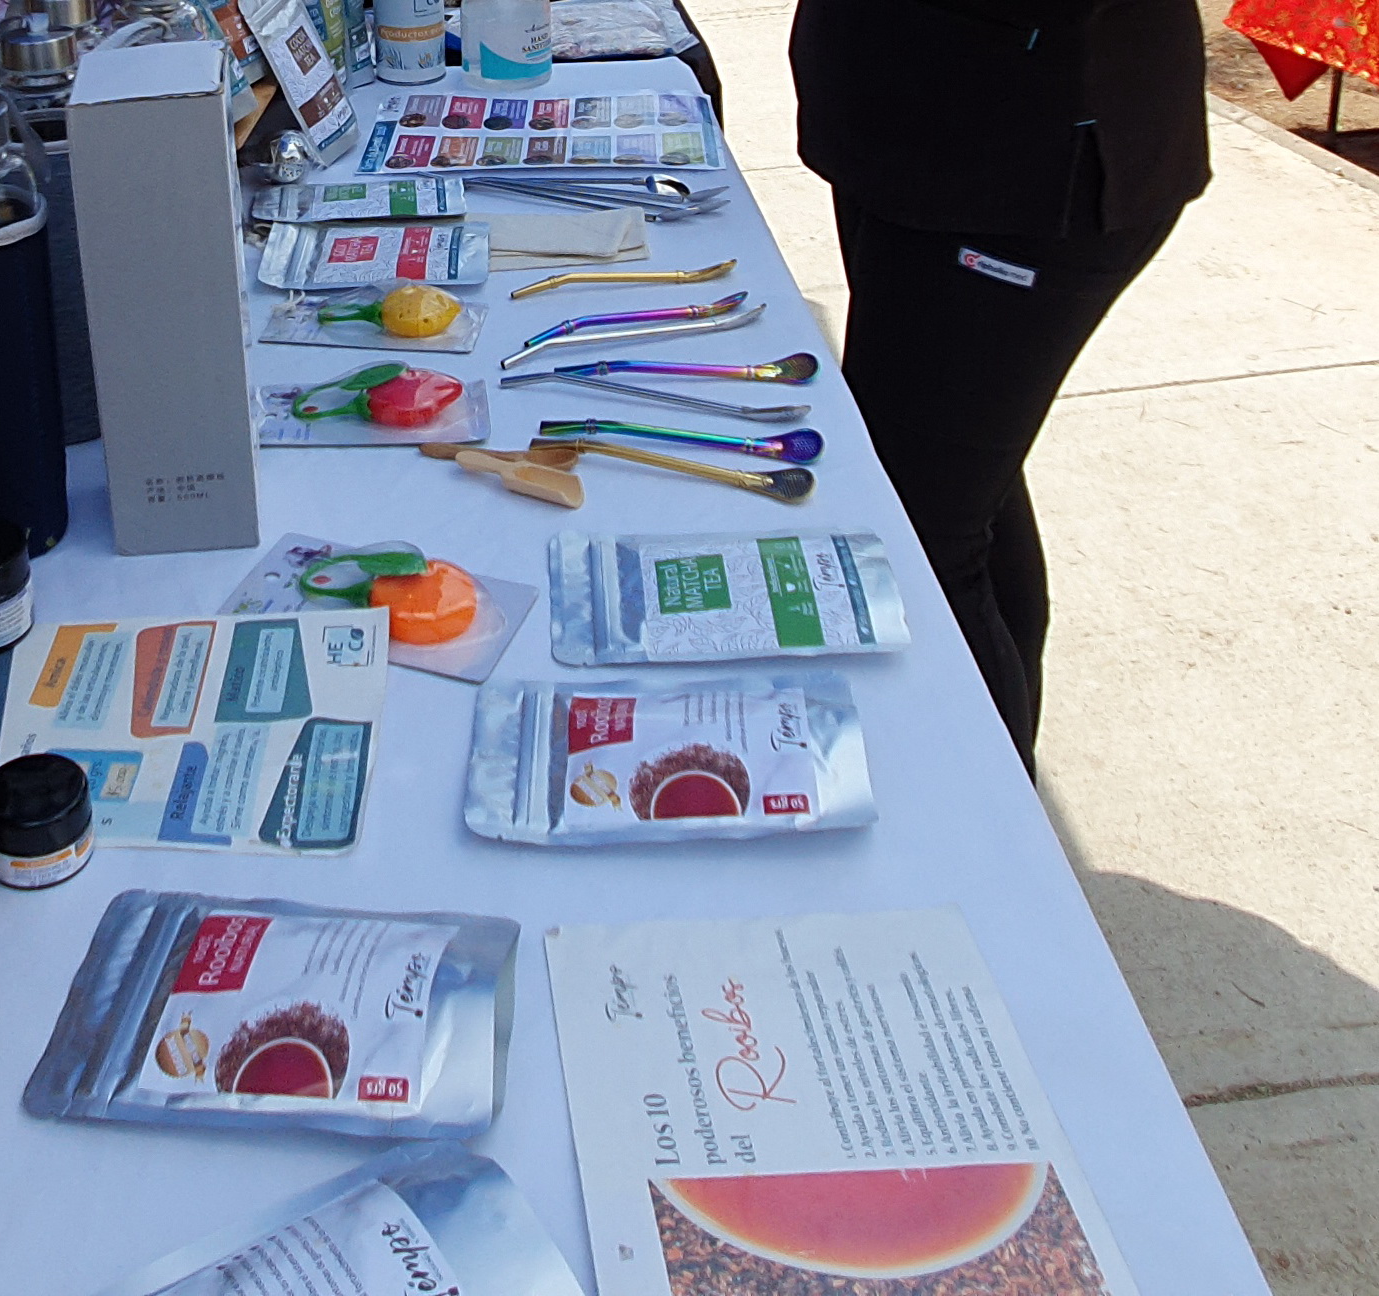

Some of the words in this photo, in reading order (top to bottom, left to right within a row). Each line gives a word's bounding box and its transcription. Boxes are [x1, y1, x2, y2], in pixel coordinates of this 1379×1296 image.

[662, 563, 679, 607] Natural
[683, 556, 704, 610] MATCHA
[703, 566, 721, 592] TEA
[327, 641, 344, 665] HE
[169, 763, 198, 822] Relajante
[277, 752, 303, 839] Expectorante
[199, 917, 248, 987] Rooibos
[663, 973, 698, 1068] beneficios
[702, 977, 797, 1112] Rooibos
[884, 1039, 909, 1081] sistema
[917, 1030, 955, 1097] irritabilidad
[939, 1030, 974, 1088] problemas
[955, 1023, 983, 1071] radicales
[849, 1050, 872, 1087] niveles
[643, 1093, 671, 1118] 10
[689, 1067, 727, 1166] poderosos
[983, 1090, 1014, 1140] Combate
[994, 1070, 1025, 1117] contiene
[821, 1089, 854, 1151] Contribuye
[850, 1113, 876, 1147] Ayuda
[869, 1107, 893, 1146] Reduce
[891, 1113, 914, 1145] Alivia
[904, 1094, 937, 1145] Equilibra
[951, 1112, 975, 1144] Alivia
[969, 1106, 996, 1140] Ayuda
[653, 1122, 681, 1168] Los
[734, 1134, 756, 1165] del
